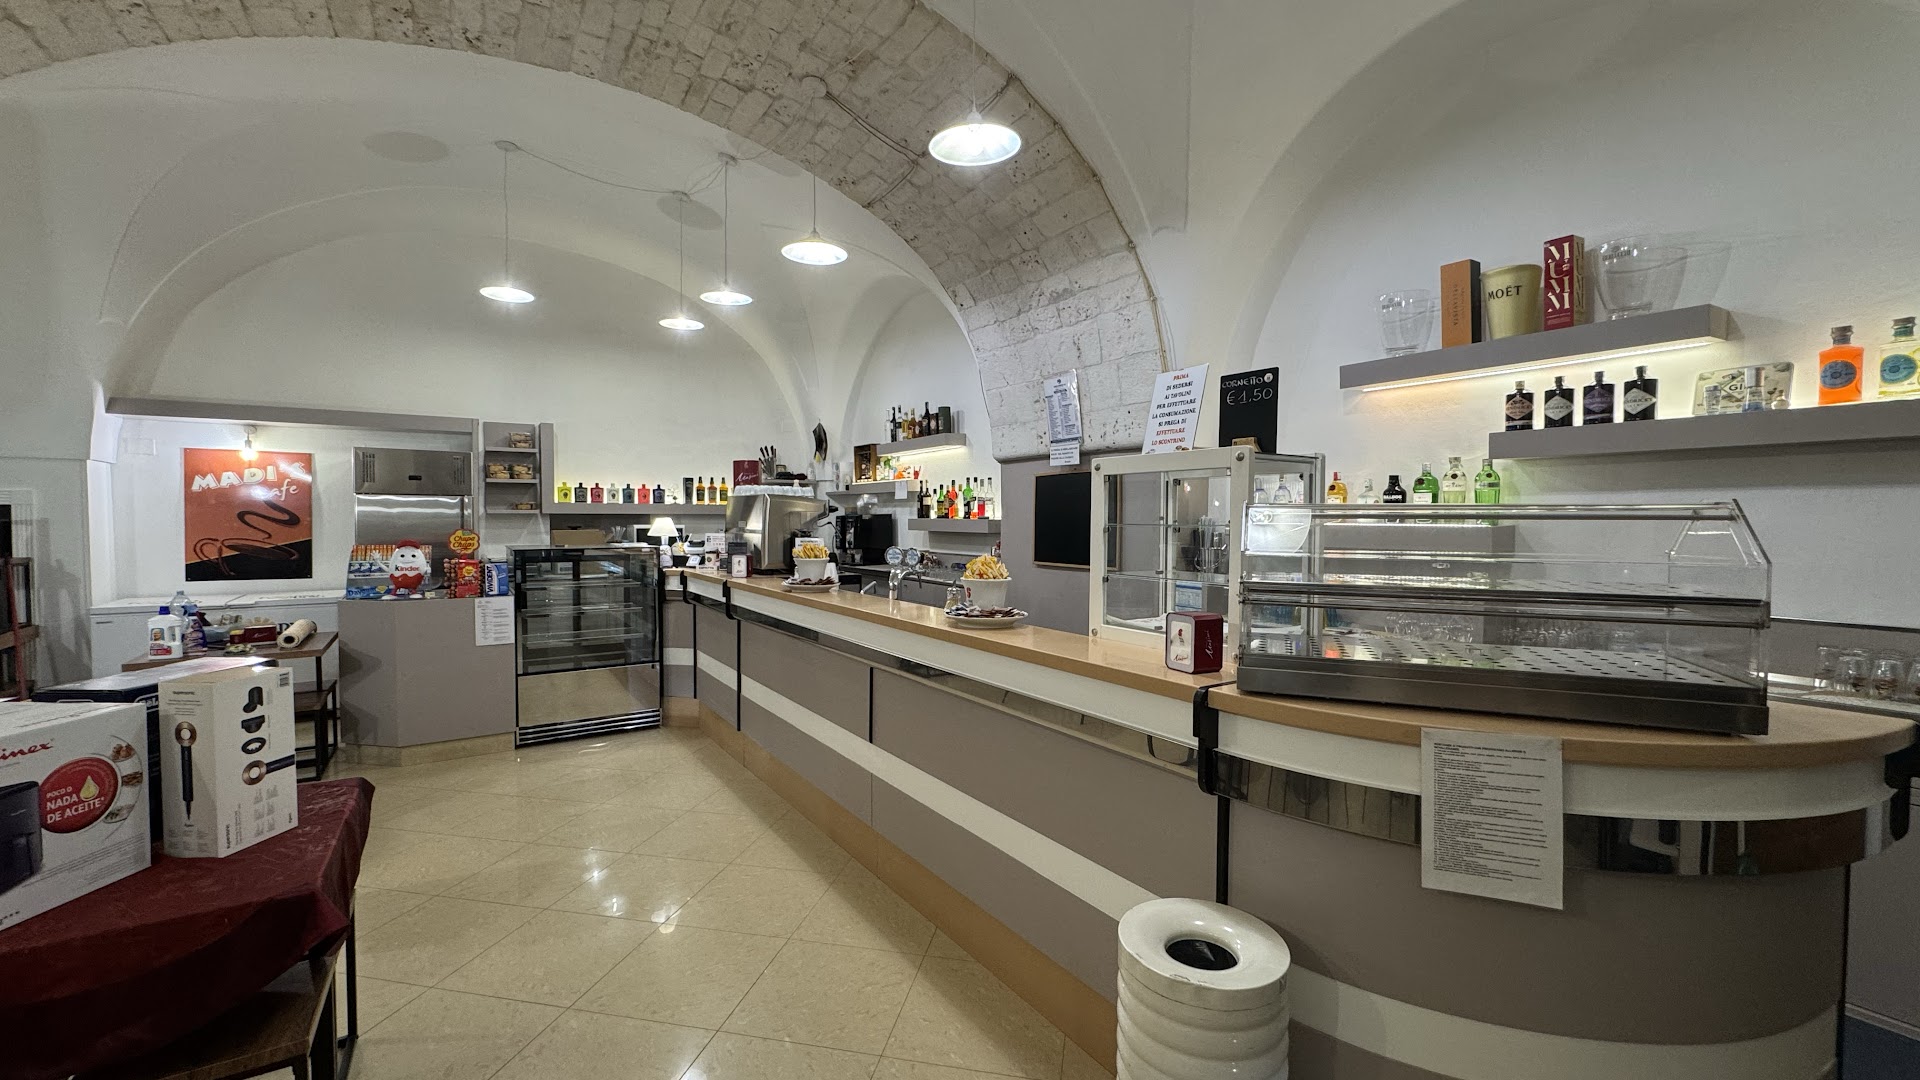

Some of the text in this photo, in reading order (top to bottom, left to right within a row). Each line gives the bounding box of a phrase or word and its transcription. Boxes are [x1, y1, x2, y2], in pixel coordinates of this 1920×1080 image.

[1488, 284, 1522, 301] MOËT
[1173, 373, 1189, 381] PRIMA
[1222, 376, 1263, 388] CORNETTO
[1172, 380, 1193, 390] SEDERSI
[1171, 390, 1192, 399] TAVOLINI
[1157, 398, 1197, 410] PER EFFETTUARE
[1159, 407, 1196, 418] CONSUMAZIONE
[1164, 419, 1180, 427] PREGA
[1156, 428, 1185, 436] EFFETTUARE
[1158, 437, 1185, 446] SCONTRINO
[453, 541, 475, 549] Chups
[46, 787, 65, 799] POCO
[46, 793, 78, 811] NADA
[47, 811, 62, 824] DE
